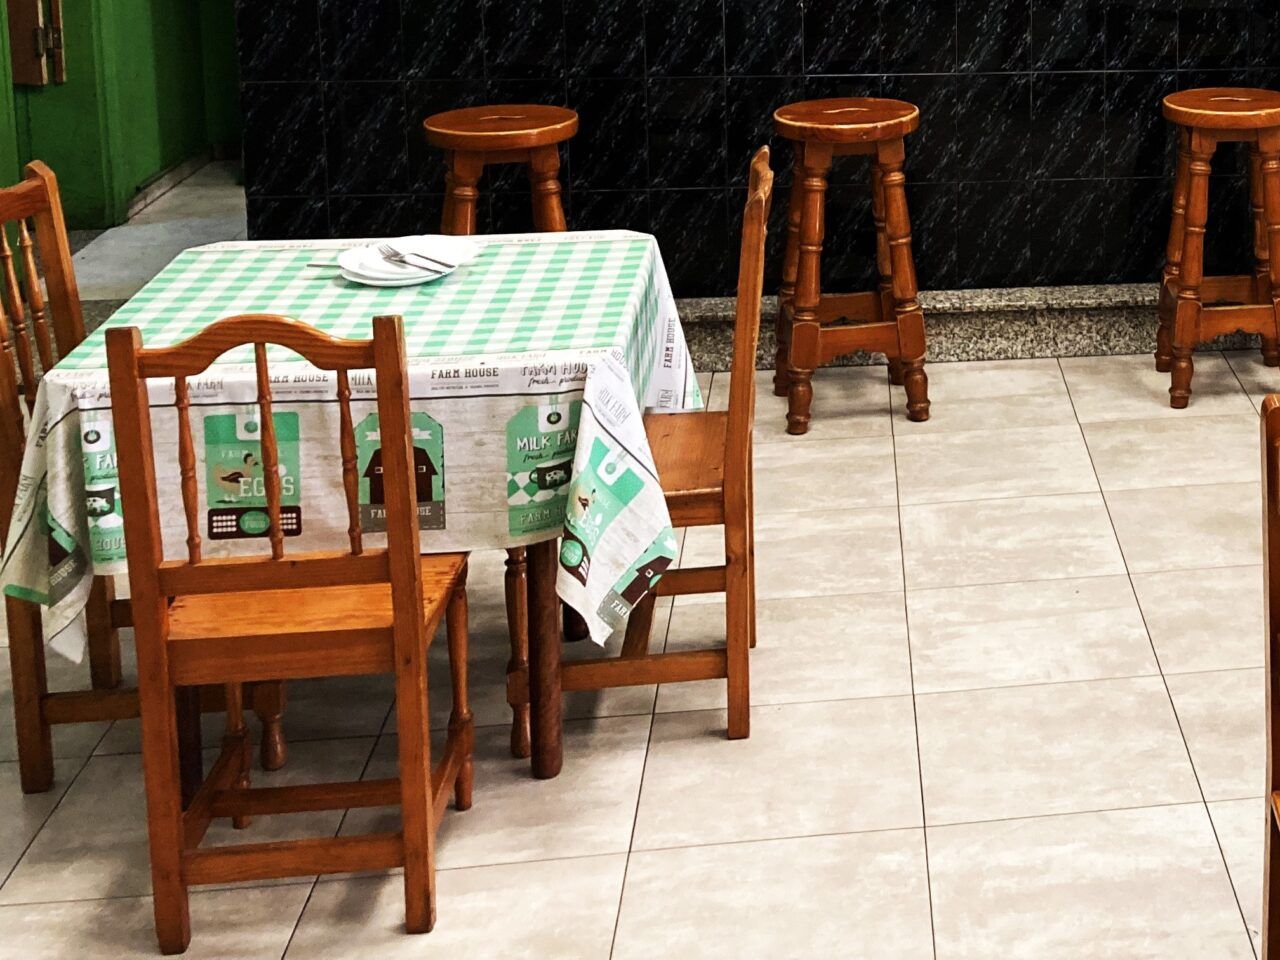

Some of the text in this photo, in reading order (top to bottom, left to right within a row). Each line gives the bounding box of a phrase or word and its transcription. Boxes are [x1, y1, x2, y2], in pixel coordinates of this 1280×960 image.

[430, 367, 499, 379] FARM HOUSE
[516, 429, 578, 452] MILK FAR
[96, 454, 117, 470] FA
[238, 476, 295, 497] EGS
